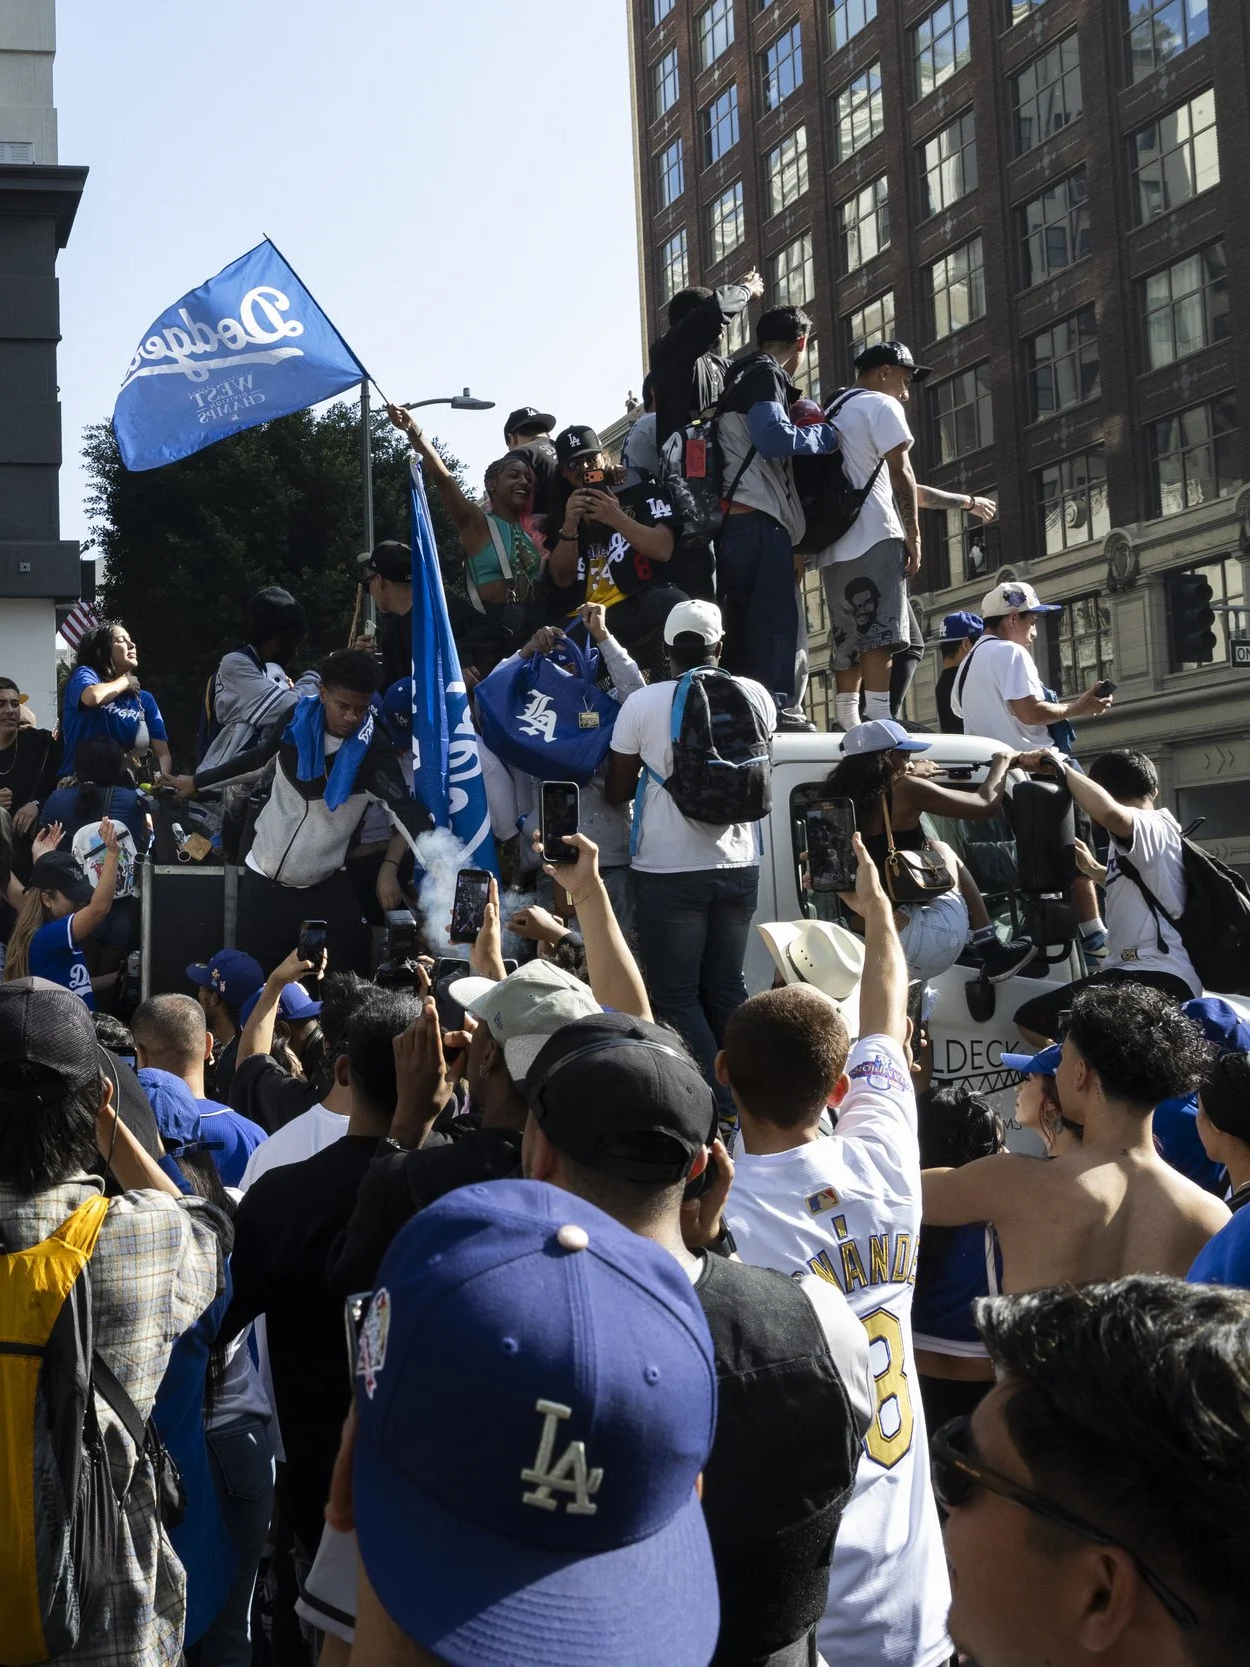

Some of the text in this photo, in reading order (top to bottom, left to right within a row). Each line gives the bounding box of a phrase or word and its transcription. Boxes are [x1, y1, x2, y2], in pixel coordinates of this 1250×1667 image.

[568, 433, 581, 448] LA
[646, 498, 673, 519] LA
[521, 1398, 604, 1515] LA
